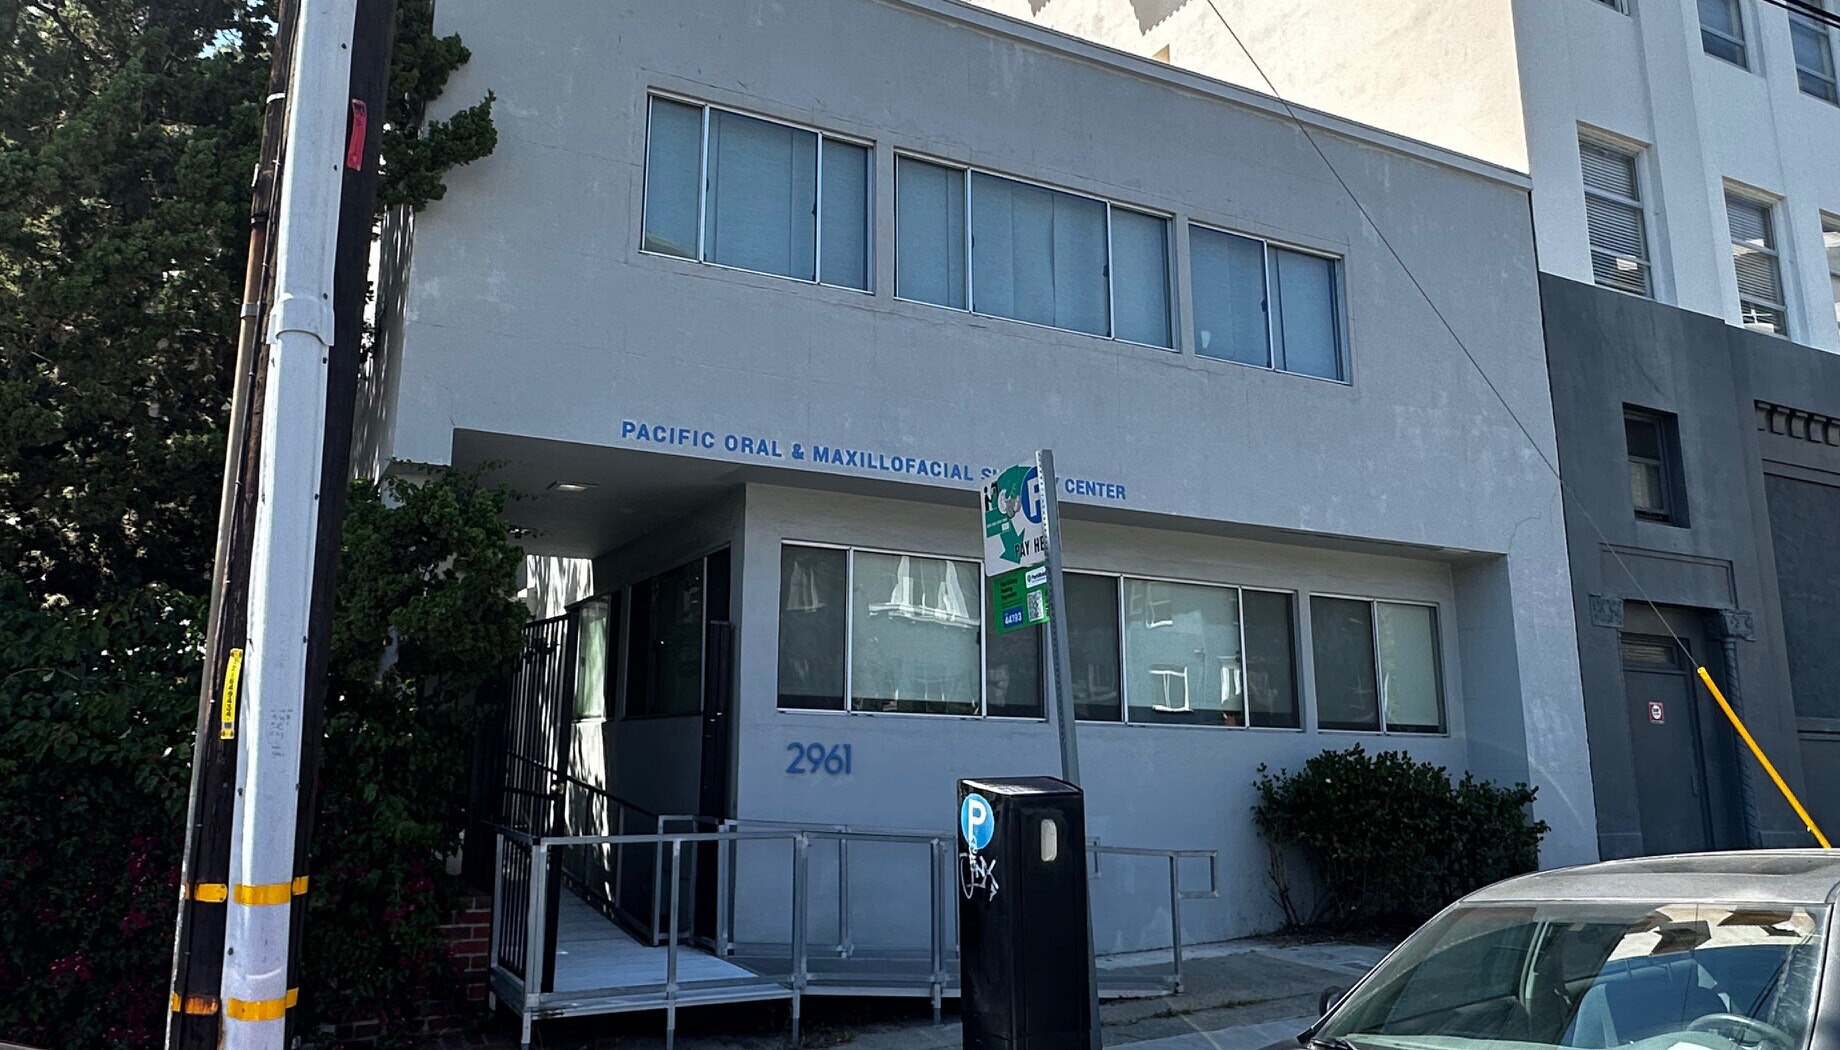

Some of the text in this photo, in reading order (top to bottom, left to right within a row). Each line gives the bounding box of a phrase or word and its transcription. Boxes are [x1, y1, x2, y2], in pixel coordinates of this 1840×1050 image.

[621, 420, 716, 449] PACIFIC
[724, 434, 783, 458] ORAL
[791, 442, 805, 460] &
[812, 445, 974, 481] MAXILLOFACIAL
[1064, 478, 1127, 500] CENTER
[1015, 540, 1030, 558] PAY
[785, 742, 852, 775] 2961
